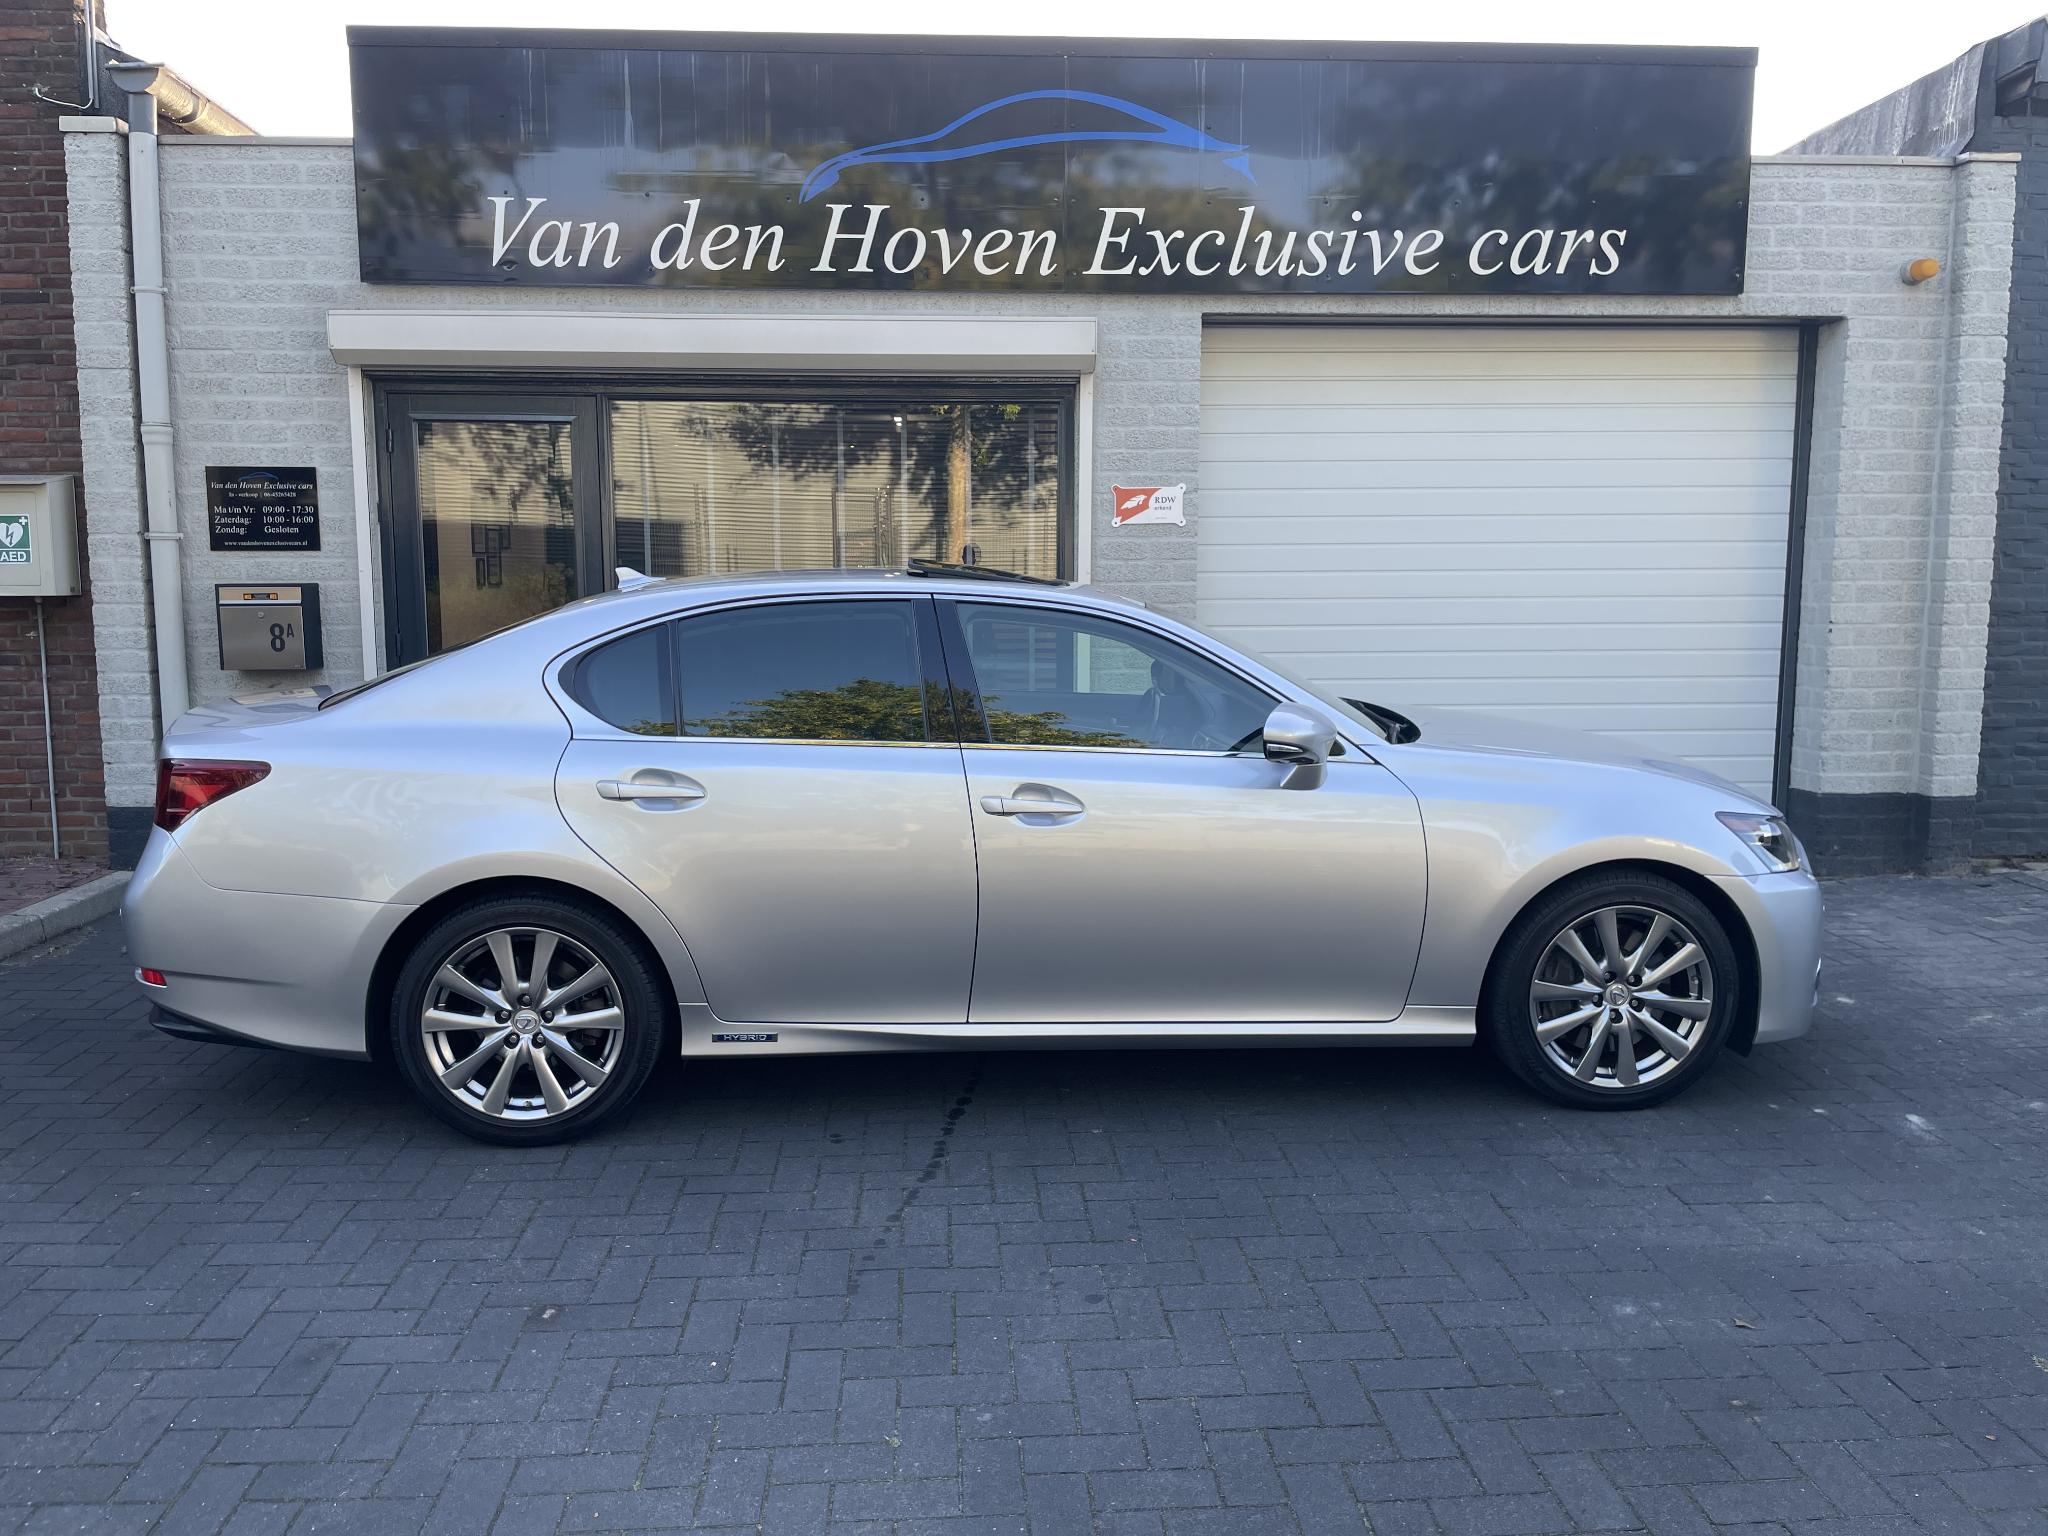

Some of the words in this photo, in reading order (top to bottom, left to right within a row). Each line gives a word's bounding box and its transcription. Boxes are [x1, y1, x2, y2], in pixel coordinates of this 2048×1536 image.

[487, 196, 622, 268] Van
[650, 198, 786, 272] den
[810, 203, 1059, 276] Hoven
[1082, 205, 1444, 277] Exclusive
[1468, 226, 1627, 276] cars
[211, 481, 224, 489] Van
[225, 481, 238, 489] den
[239, 481, 262, 489] Hoven
[263, 481, 297, 490] Exclusive
[1154, 495, 1177, 504] RDW
[214, 505, 227, 514] Ma
[228, 505, 242, 514] t/m
[243, 505, 256, 514] Vr:
[262, 505, 285, 514] 09:00
[292, 505, 314, 514] 17:30
[214, 515, 252, 525] Zaterdag:
[263, 515, 285, 524] 10:00
[292, 515, 314, 524] 16:00
[215, 525, 248, 535] Zondag:
[264, 525, 299, 534] Gesloten
[0, 551, 27, 562] AED
